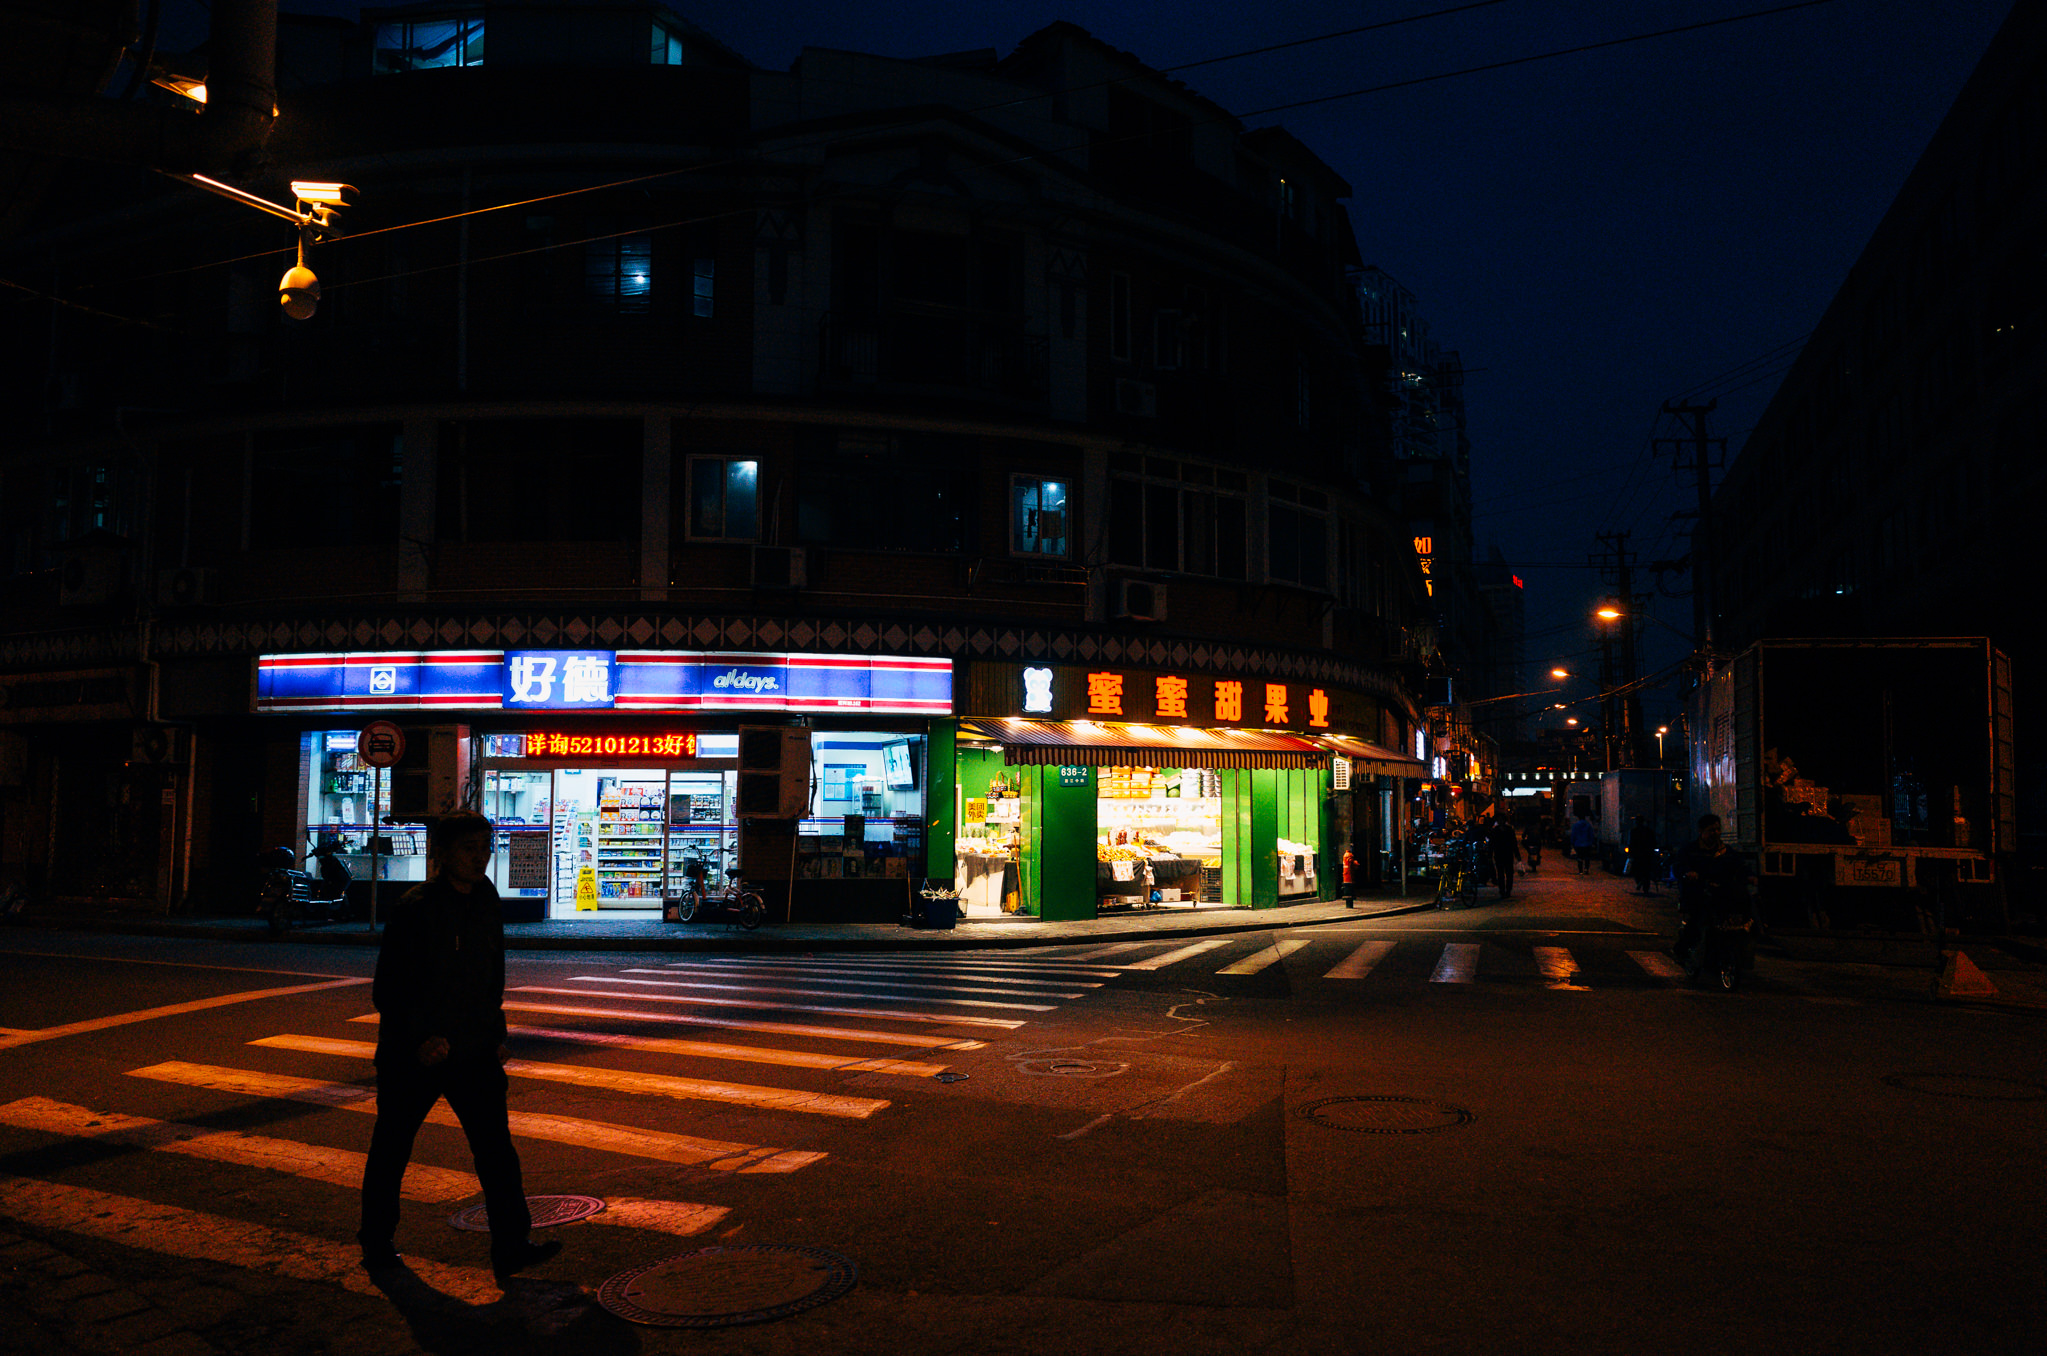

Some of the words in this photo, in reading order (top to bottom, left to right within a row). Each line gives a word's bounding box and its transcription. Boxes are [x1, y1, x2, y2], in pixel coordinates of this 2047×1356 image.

[509, 656, 609, 702] 好德
[1087, 671, 1329, 728] 蜜蜜甜果业
[1060, 767, 1088, 777] 636-2
